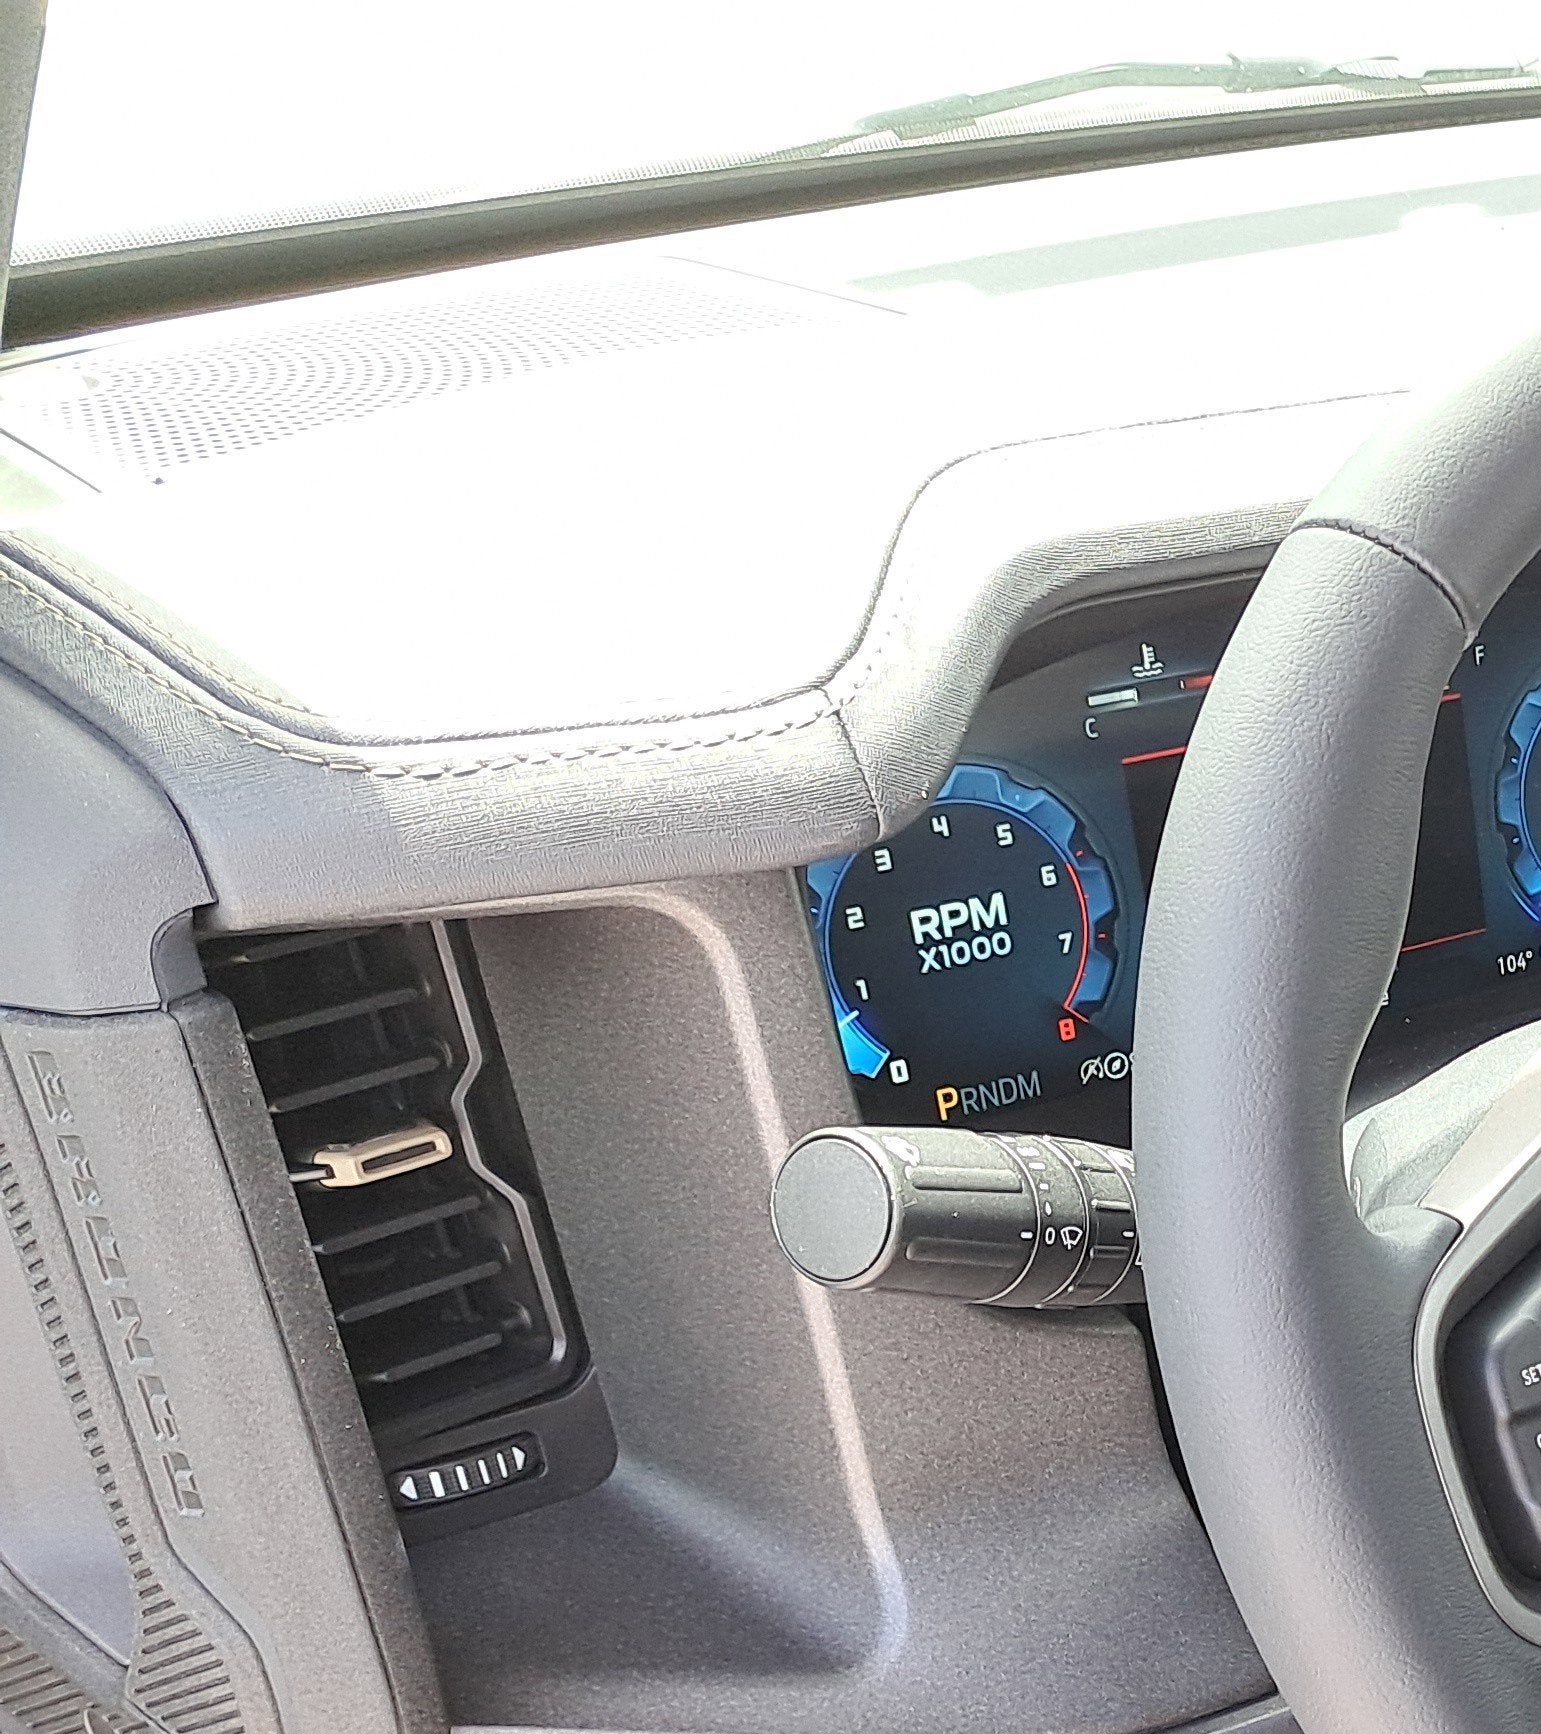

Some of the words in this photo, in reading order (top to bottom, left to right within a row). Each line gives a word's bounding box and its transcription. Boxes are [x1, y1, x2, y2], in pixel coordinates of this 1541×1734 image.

[1474, 644, 1486, 666] F
[1085, 717, 1099, 739] C
[931, 815, 950, 838] 4
[995, 823, 1014, 847] 5
[874, 848, 894, 872] 3
[1040, 864, 1060, 888] 6
[846, 906, 866, 931] 2
[909, 891, 1010, 944] RPM
[918, 931, 1013, 974] X1000
[1059, 931, 1074, 955] 7
[855, 979, 870, 1001] 1
[1058, 1018, 1076, 1041] 8
[889, 1059, 910, 1084] 0
[26, 1050, 205, 1518] BRONCO
